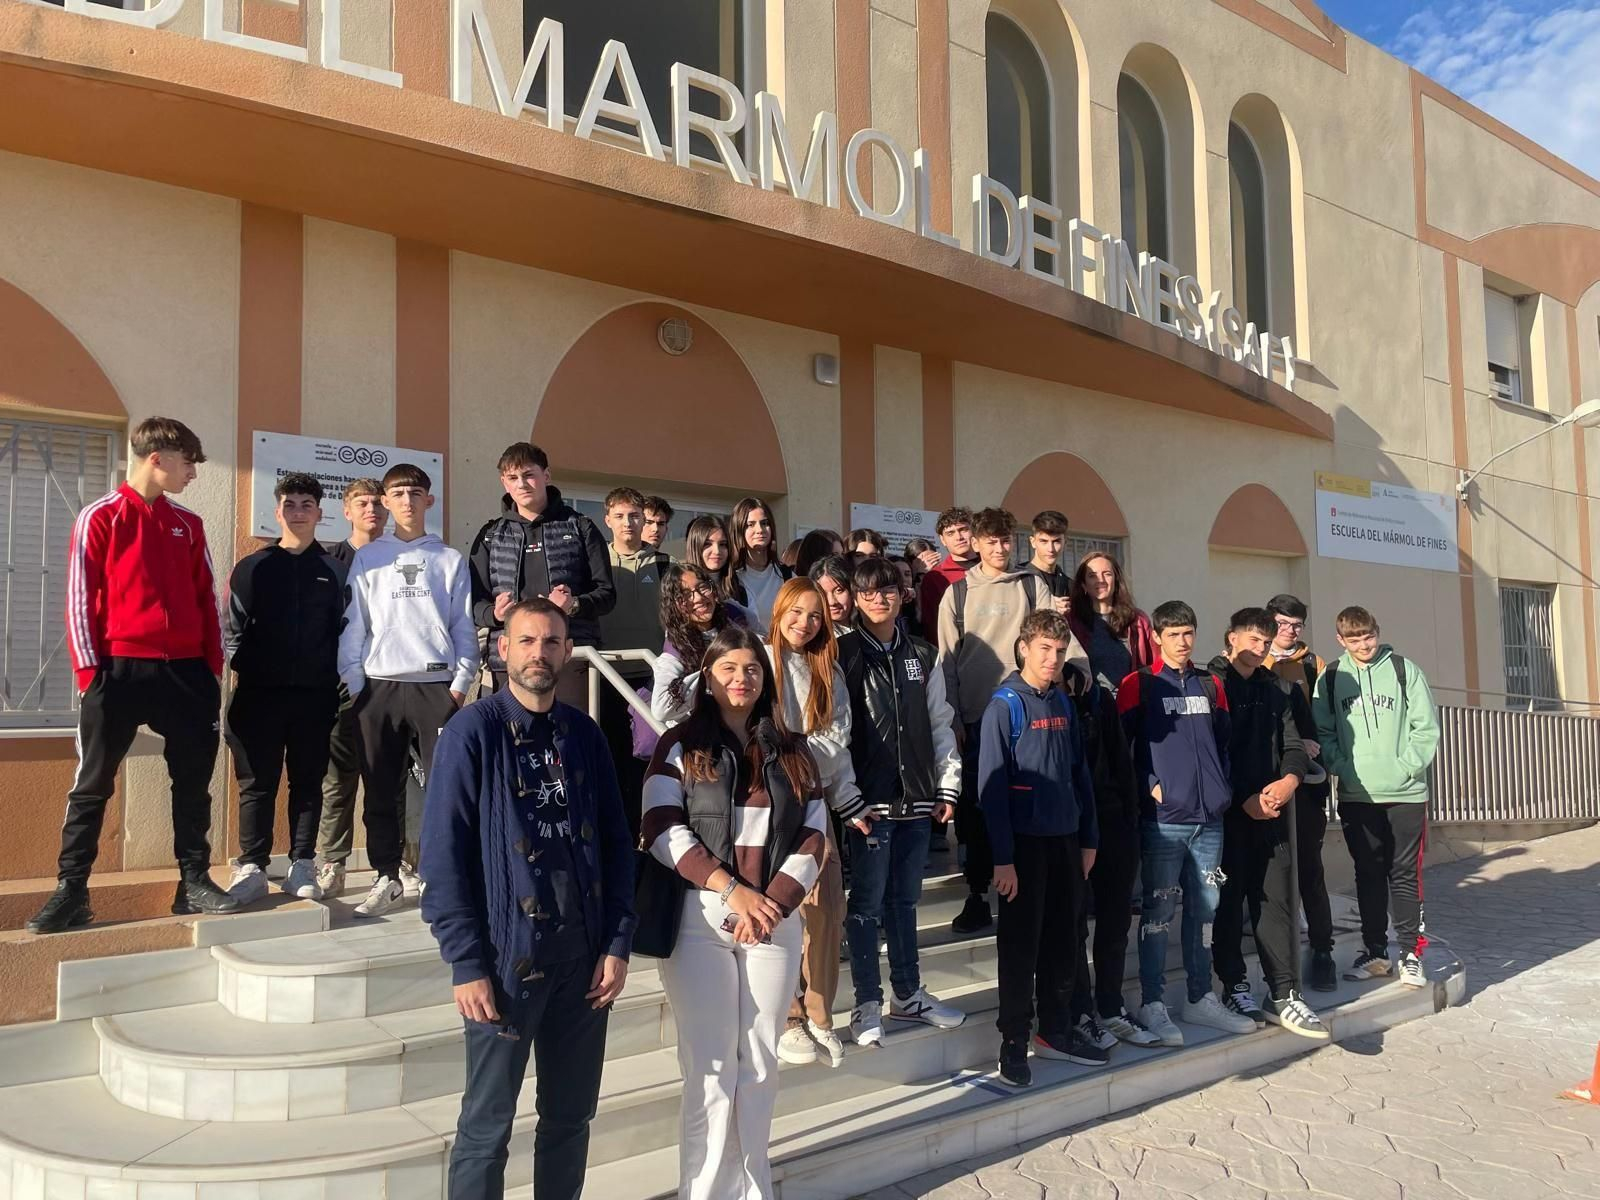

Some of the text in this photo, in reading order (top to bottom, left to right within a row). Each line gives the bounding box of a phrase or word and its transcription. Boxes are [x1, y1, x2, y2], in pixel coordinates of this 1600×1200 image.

[451, 0, 960, 249] MARMOL
[972, 172, 1065, 286] DE
[1069, 218, 1203, 342] FINES
[1331, 523, 1447, 550] ESCUELA DEL MÁRMOL DE FINES
